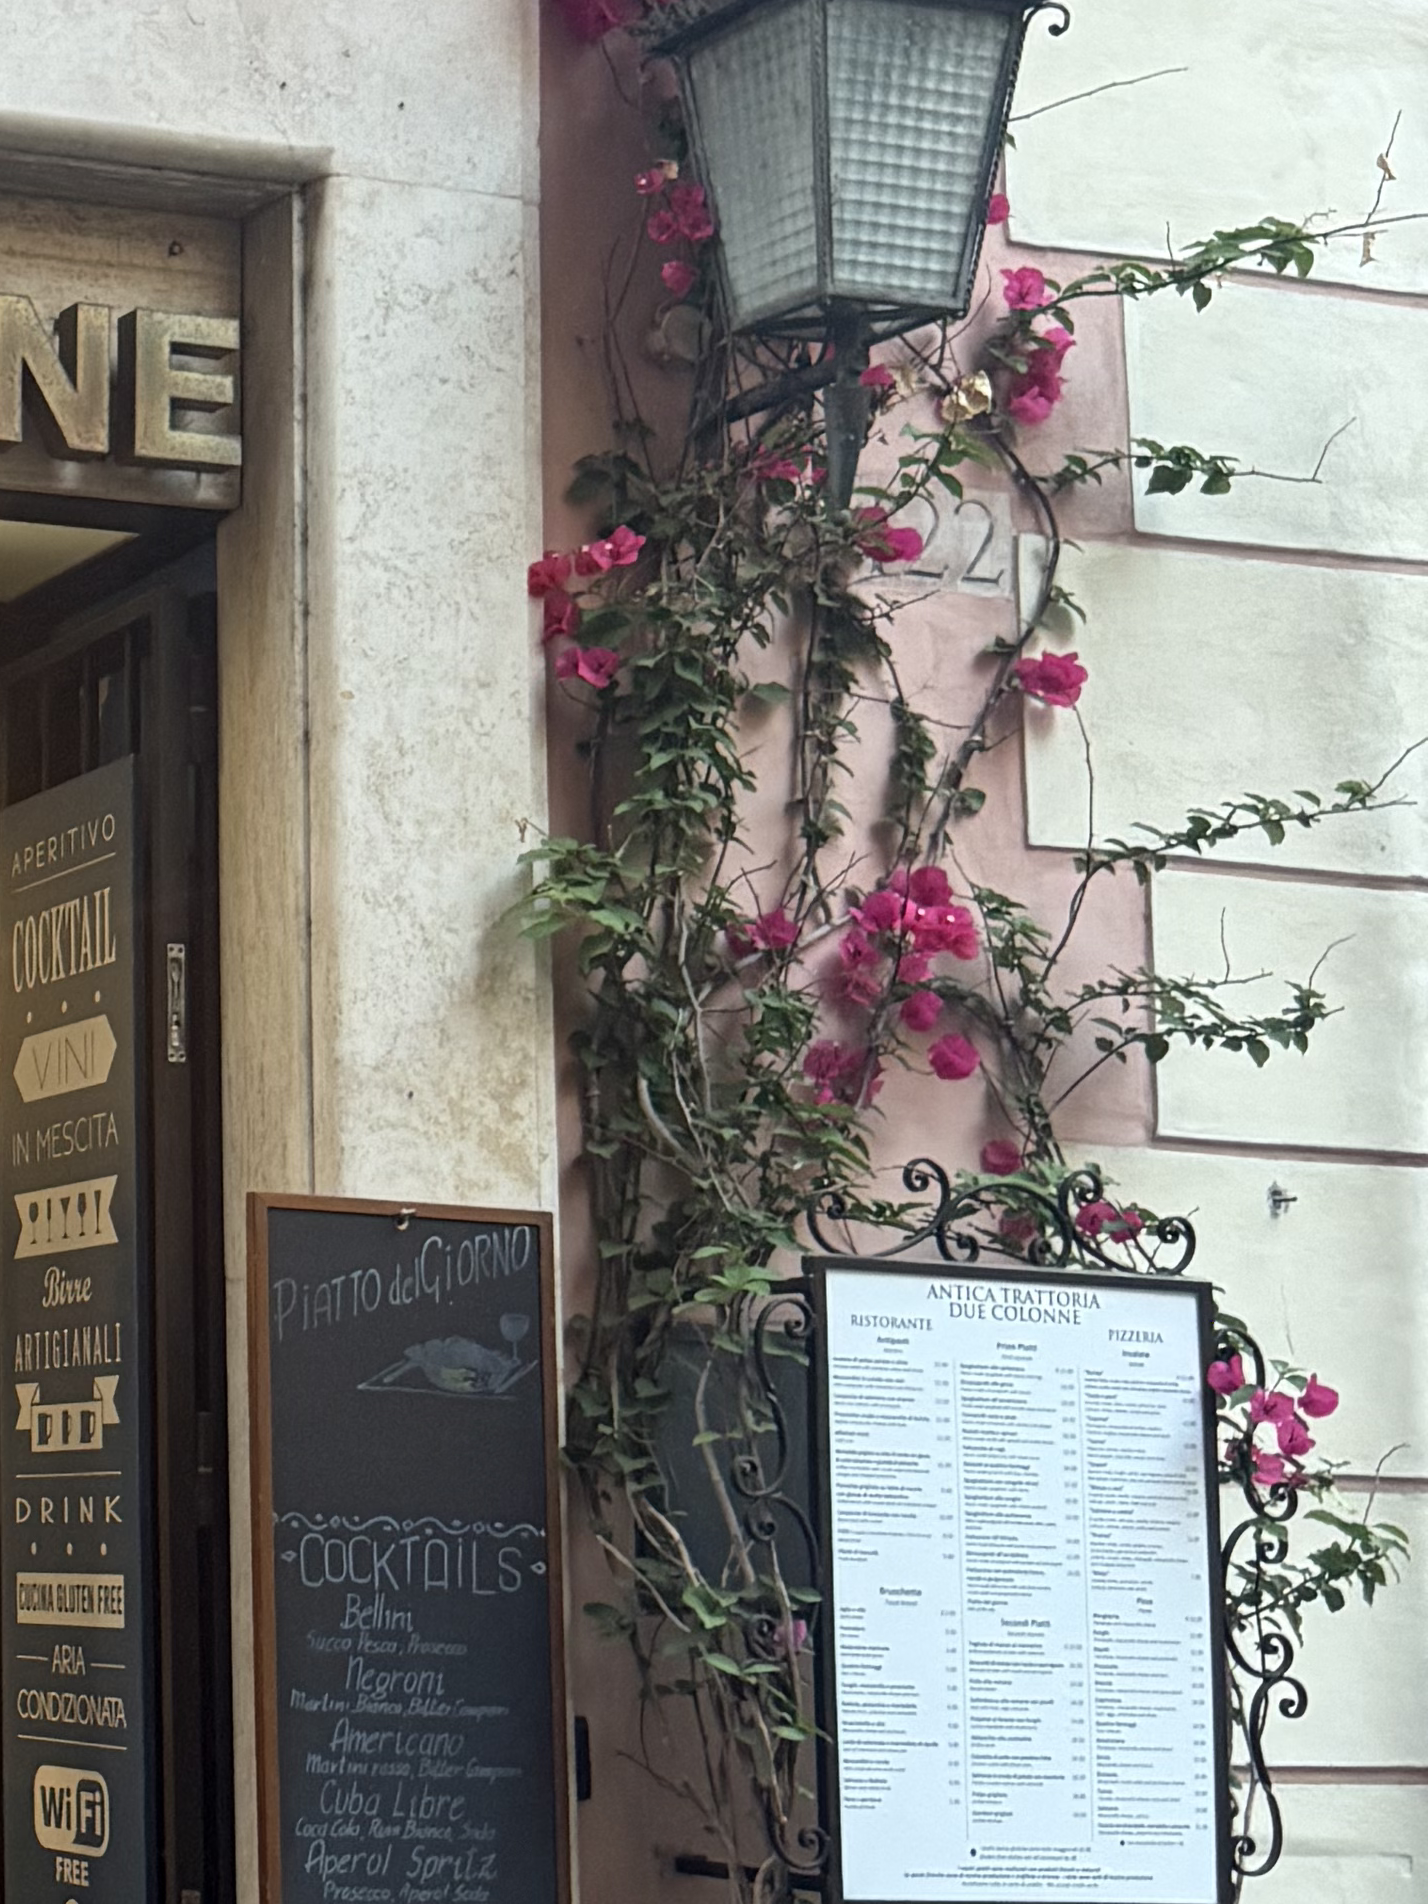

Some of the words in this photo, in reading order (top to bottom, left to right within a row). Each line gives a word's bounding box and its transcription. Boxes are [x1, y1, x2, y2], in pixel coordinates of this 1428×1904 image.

[11, 812, 117, 878] APERITIVO
[12, 886, 117, 995] COCKTAIL
[30, 1029, 97, 1090] VINI
[12, 1129, 30, 1167] IN
[36, 1110, 119, 1163] MESCITA
[42, 1265, 94, 1308] Birre
[926, 1283, 996, 1303] ANTICA
[1000, 1286, 1101, 1309] TRATTORIA
[850, 1314, 933, 1331] RISTORANTE
[949, 1302, 987, 1320] DUE
[991, 1304, 1082, 1326] COLONNE
[13, 1321, 122, 1373] ARTIGIANALI
[1107, 1328, 1164, 1344] PIZZERIA
[15, 1495, 123, 1524] DRINK
[298, 1533, 524, 1595] COCKTAILS
[97, 1585, 124, 1615] FREE
[339, 1592, 414, 1634] Bellini
[51, 1644, 86, 1676] ARIA
[344, 1655, 445, 1700] Negroni
[16, 1687, 128, 1730] CONDIZIONATA
[329, 1717, 465, 1758] Americano
[319, 1779, 380, 1817] Cuba
[392, 1781, 466, 1821] Libre
[55, 1855, 90, 1887] FREE
[304, 1838, 392, 1881] Aperol
[406, 1845, 499, 1885] Spritz
